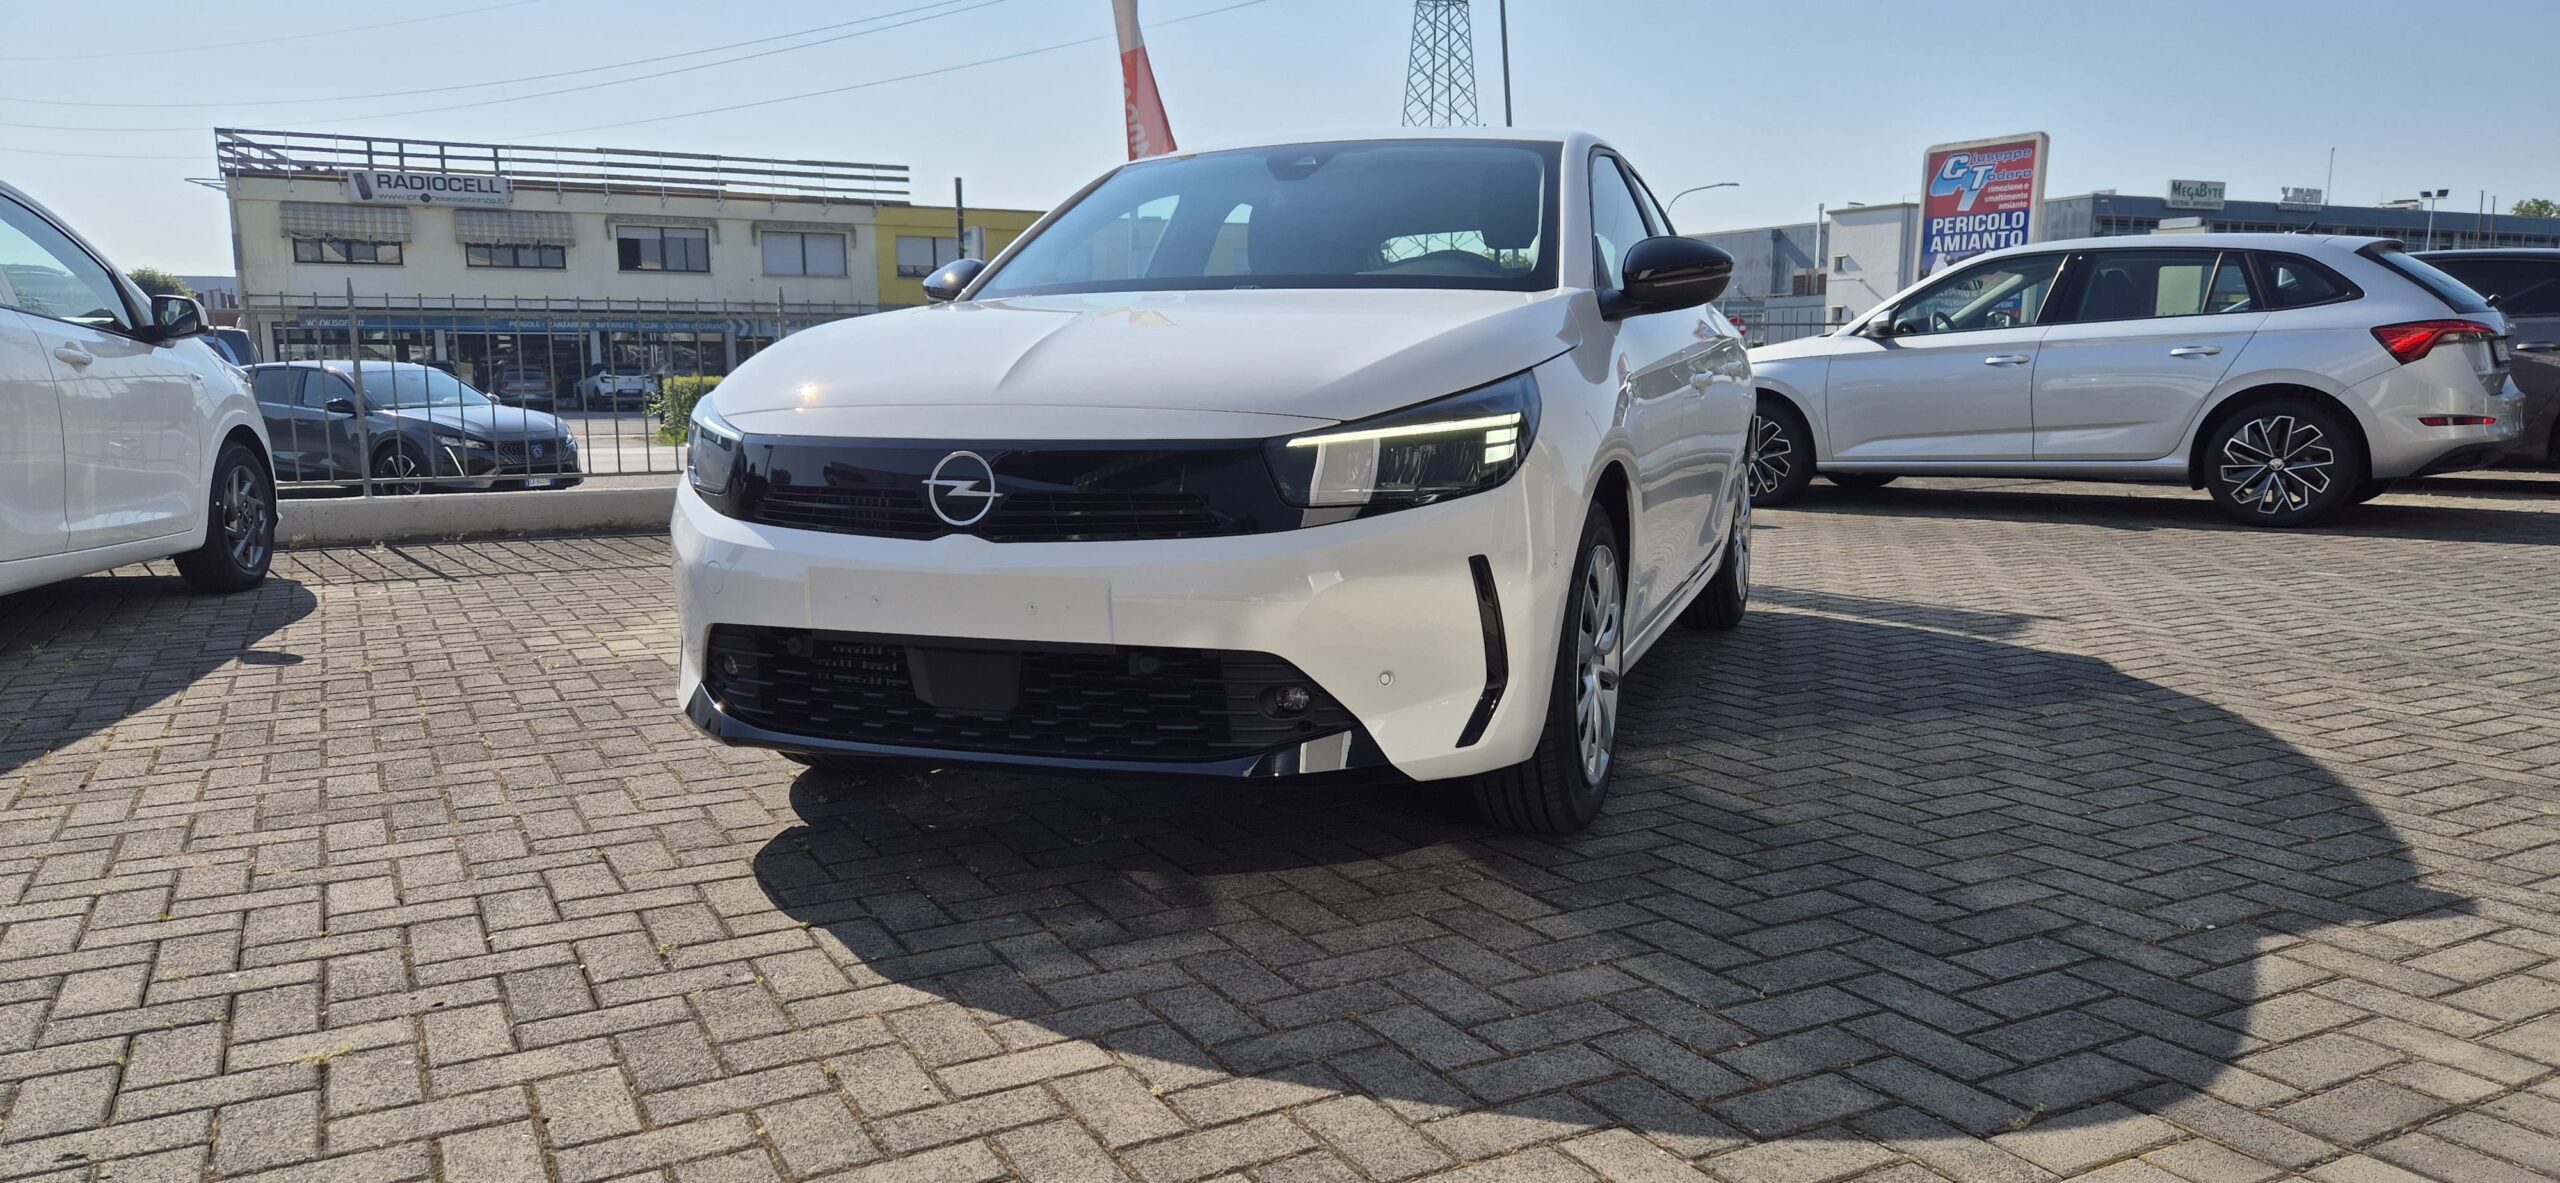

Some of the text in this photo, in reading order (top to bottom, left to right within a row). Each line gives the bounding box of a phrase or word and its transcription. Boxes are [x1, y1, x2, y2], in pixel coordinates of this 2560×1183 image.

[377, 174, 501, 194] RADIOCELL
[1988, 184, 2022, 193] rimozione
[1984, 192, 2028, 203] smaltimento
[1998, 201, 2028, 210] amianto
[1932, 211, 2025, 235] PERICOLO
[1930, 230, 2023, 252] AMIANTO
